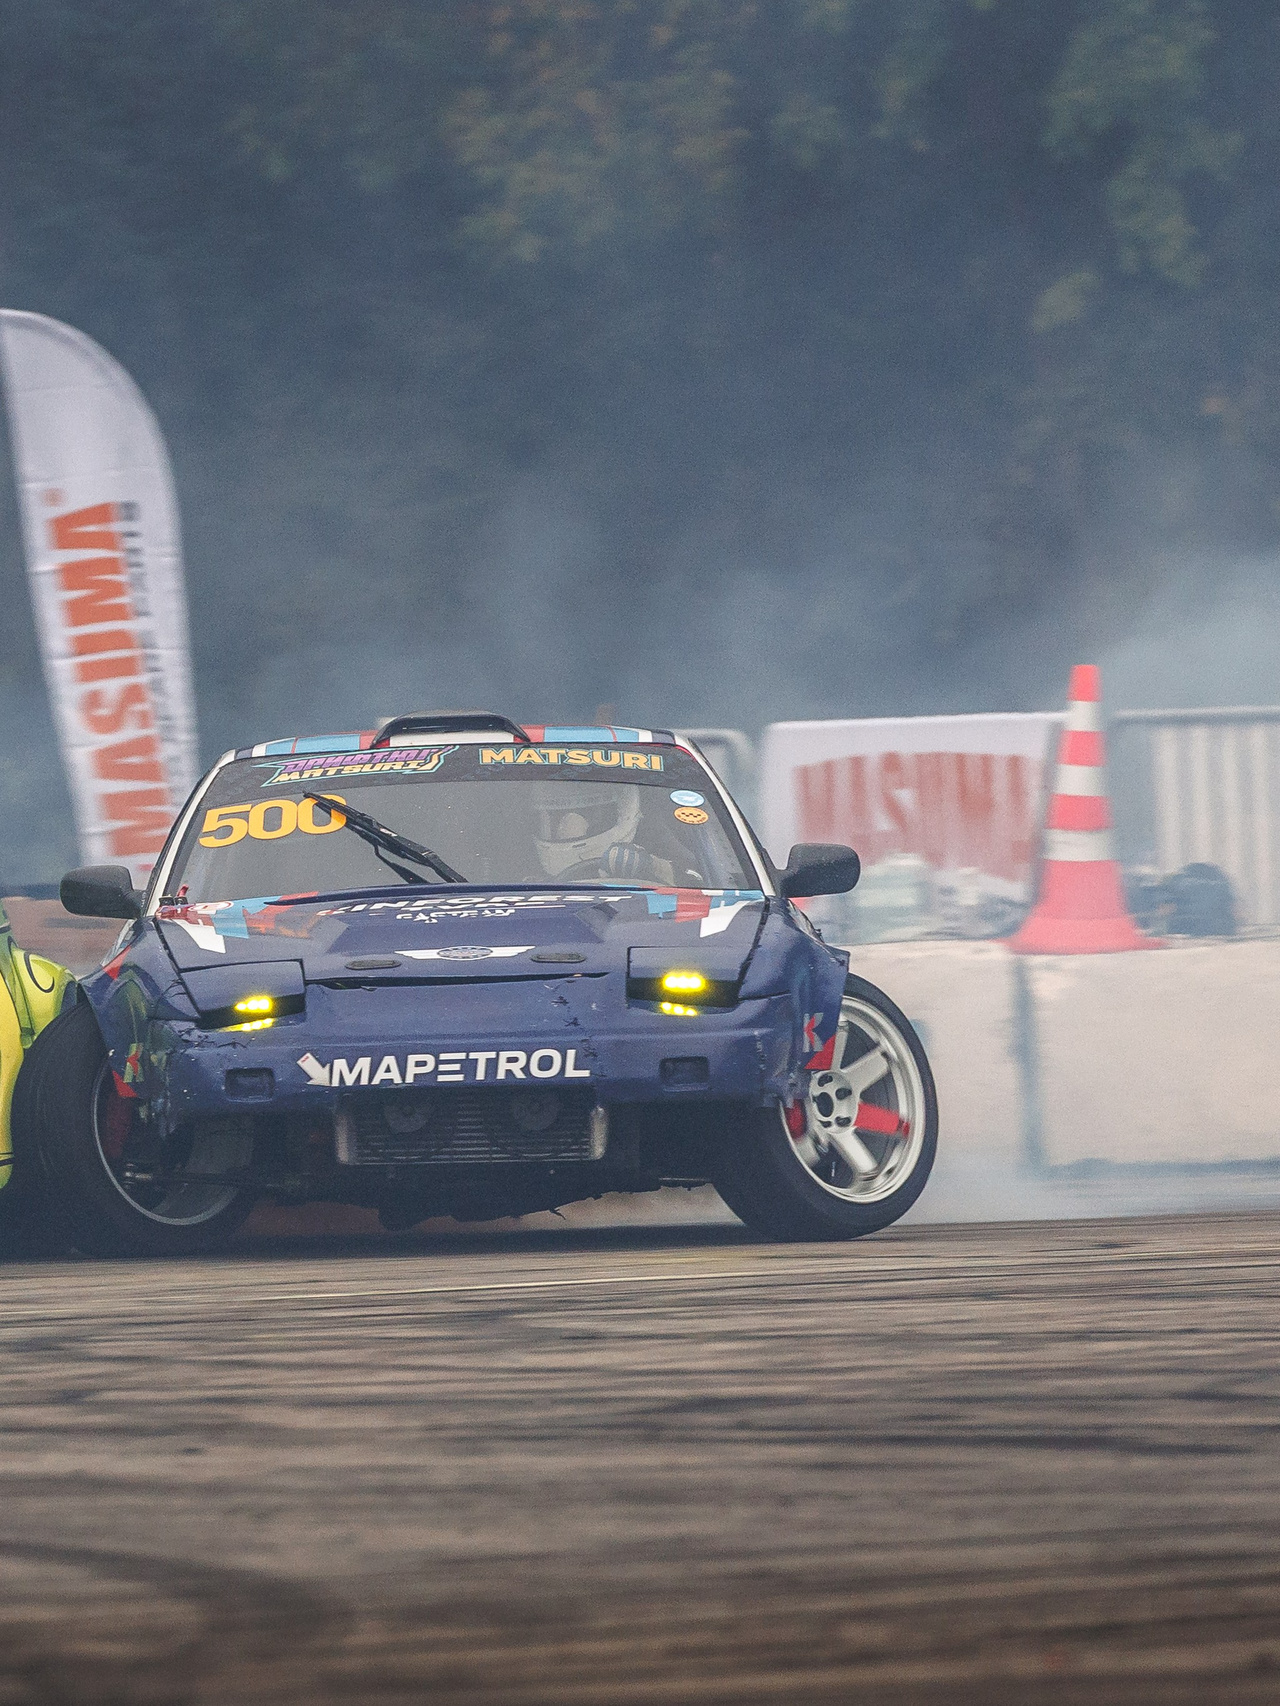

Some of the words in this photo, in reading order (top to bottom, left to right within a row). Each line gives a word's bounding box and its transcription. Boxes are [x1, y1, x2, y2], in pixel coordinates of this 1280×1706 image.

[47, 500, 176, 858] MASUMA
[272, 760, 434, 783] MATSURI
[480, 749, 663, 771] MATSURI
[199, 794, 347, 848] 500
[331, 1048, 591, 1087] MAPETROL
